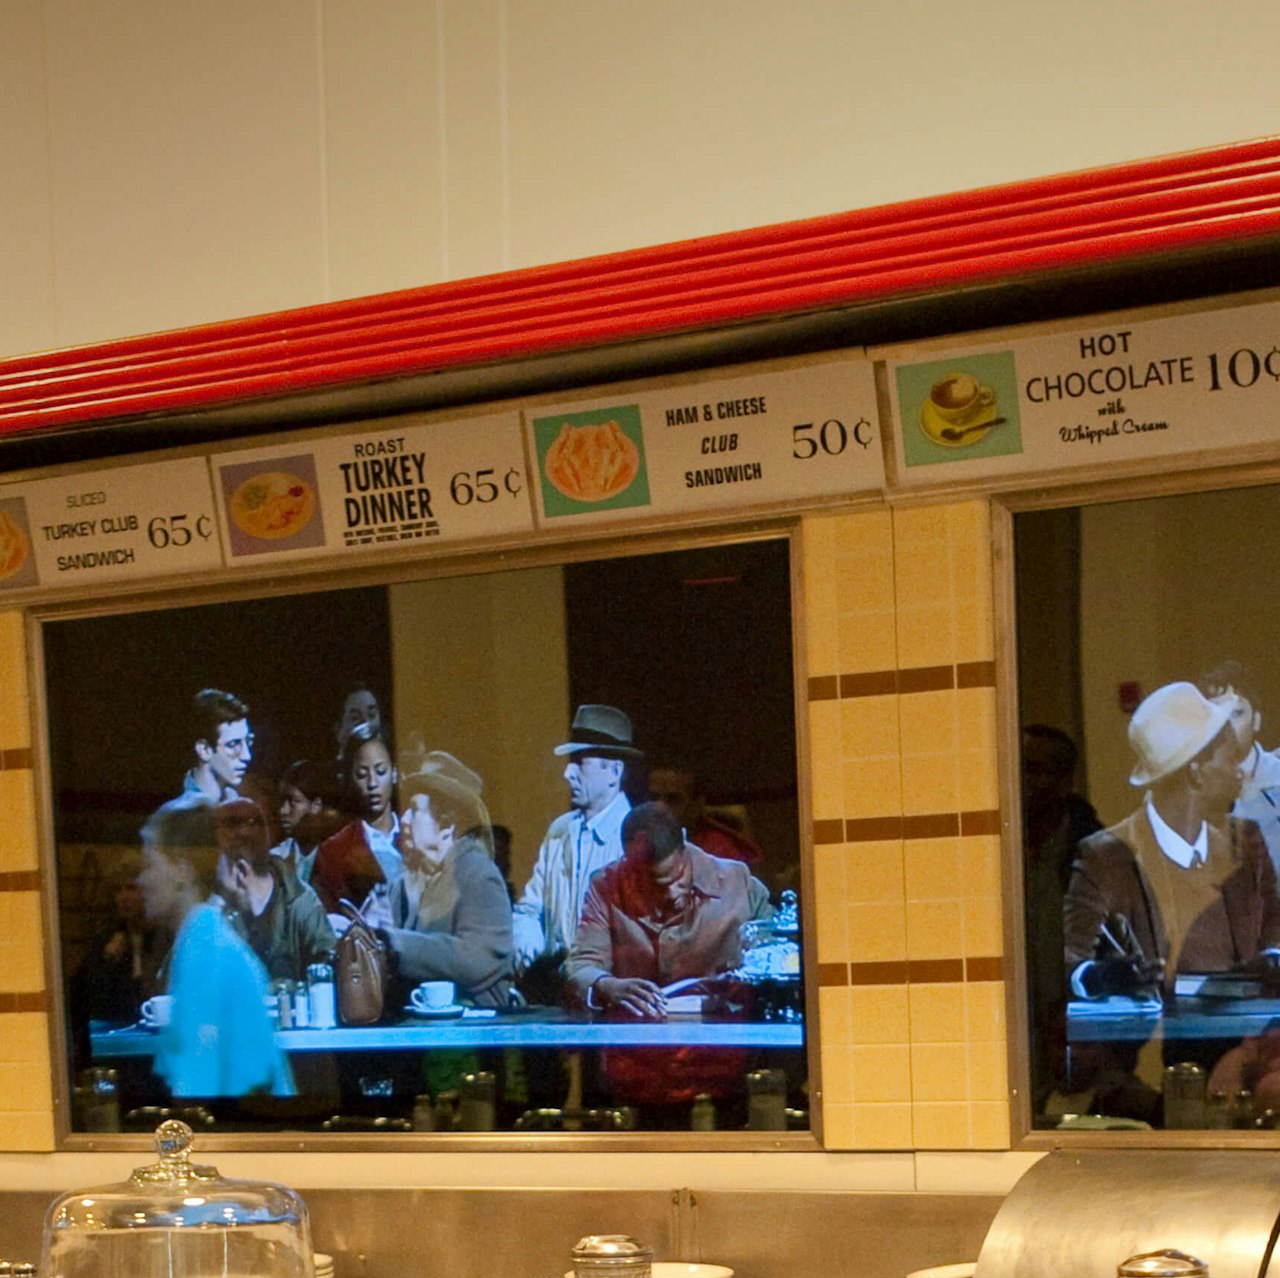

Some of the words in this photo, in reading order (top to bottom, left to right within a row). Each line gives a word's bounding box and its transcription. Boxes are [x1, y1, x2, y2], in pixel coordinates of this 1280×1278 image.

[1080, 331, 1132, 358] HOT
[1025, 357, 1194, 403] CHOCOLATE
[665, 407, 698, 427] HAM
[703, 404, 713, 421] &
[717, 397, 767, 419] CHEESE
[1098, 398, 1125, 416] with
[792, 417, 873, 460] 50¢
[1059, 420, 1119, 443] Whipped
[1122, 418, 1168, 433] Cream
[354, 437, 405, 457] ROAST
[701, 433, 739, 455] CLUB
[339, 452, 426, 493] TURKEY
[685, 462, 762, 488] SANDWICH
[66, 491, 106, 508] SLICED
[450, 467, 522, 506] 65¢
[344, 488, 434, 527] DINNER
[42, 520, 97, 541] TURKEY
[101, 515, 139, 534] CLUB
[148, 514, 212, 549] 65¢
[57, 548, 135, 571] SANDWICH
